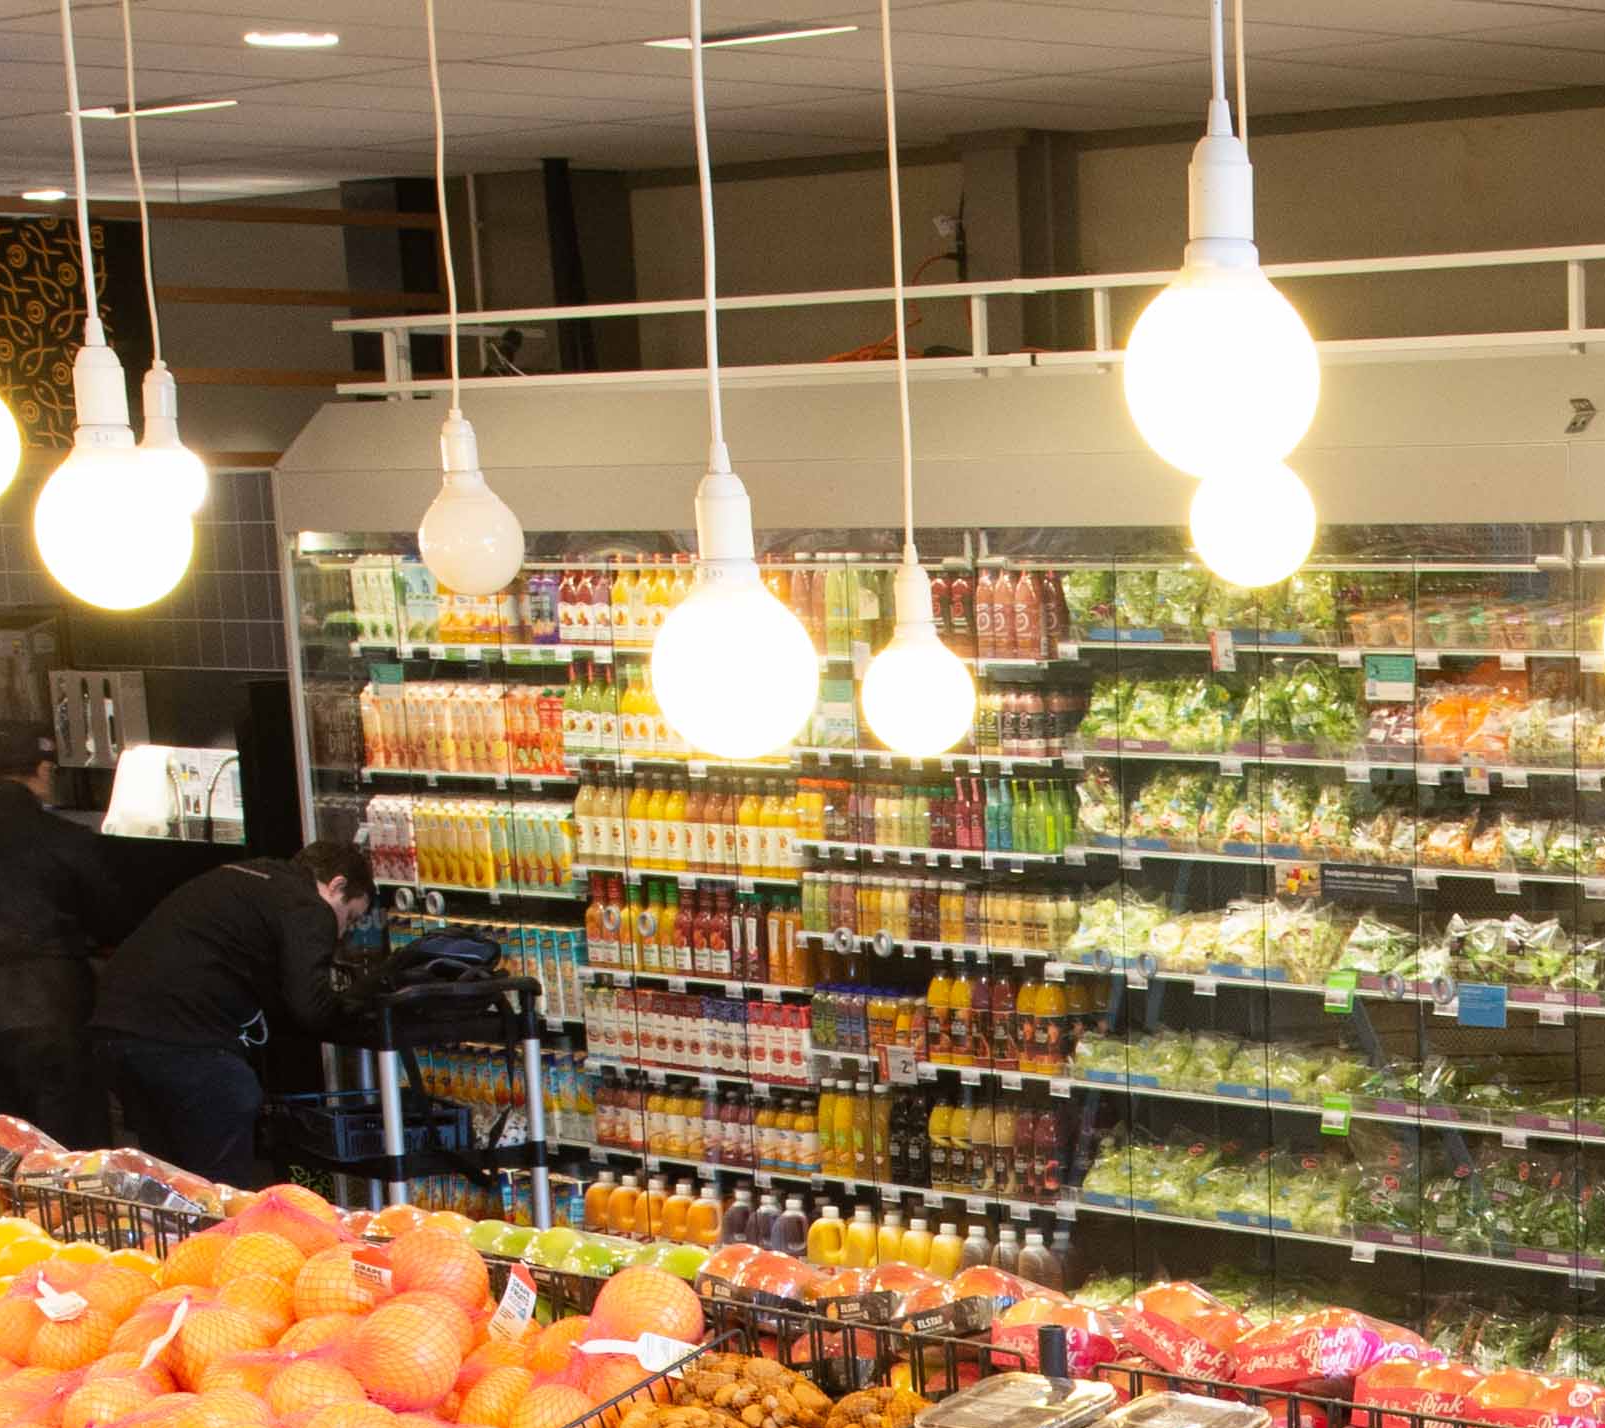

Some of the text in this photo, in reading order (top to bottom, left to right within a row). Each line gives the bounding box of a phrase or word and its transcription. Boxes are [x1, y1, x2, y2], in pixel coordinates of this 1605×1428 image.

[917, 1316, 944, 1331] ELSTAR
[1180, 1337, 1226, 1367] Pink
[1297, 1334, 1347, 1360] Pink
[1307, 1355, 1351, 1379] Lady
[1412, 1392, 1464, 1416] Pink
